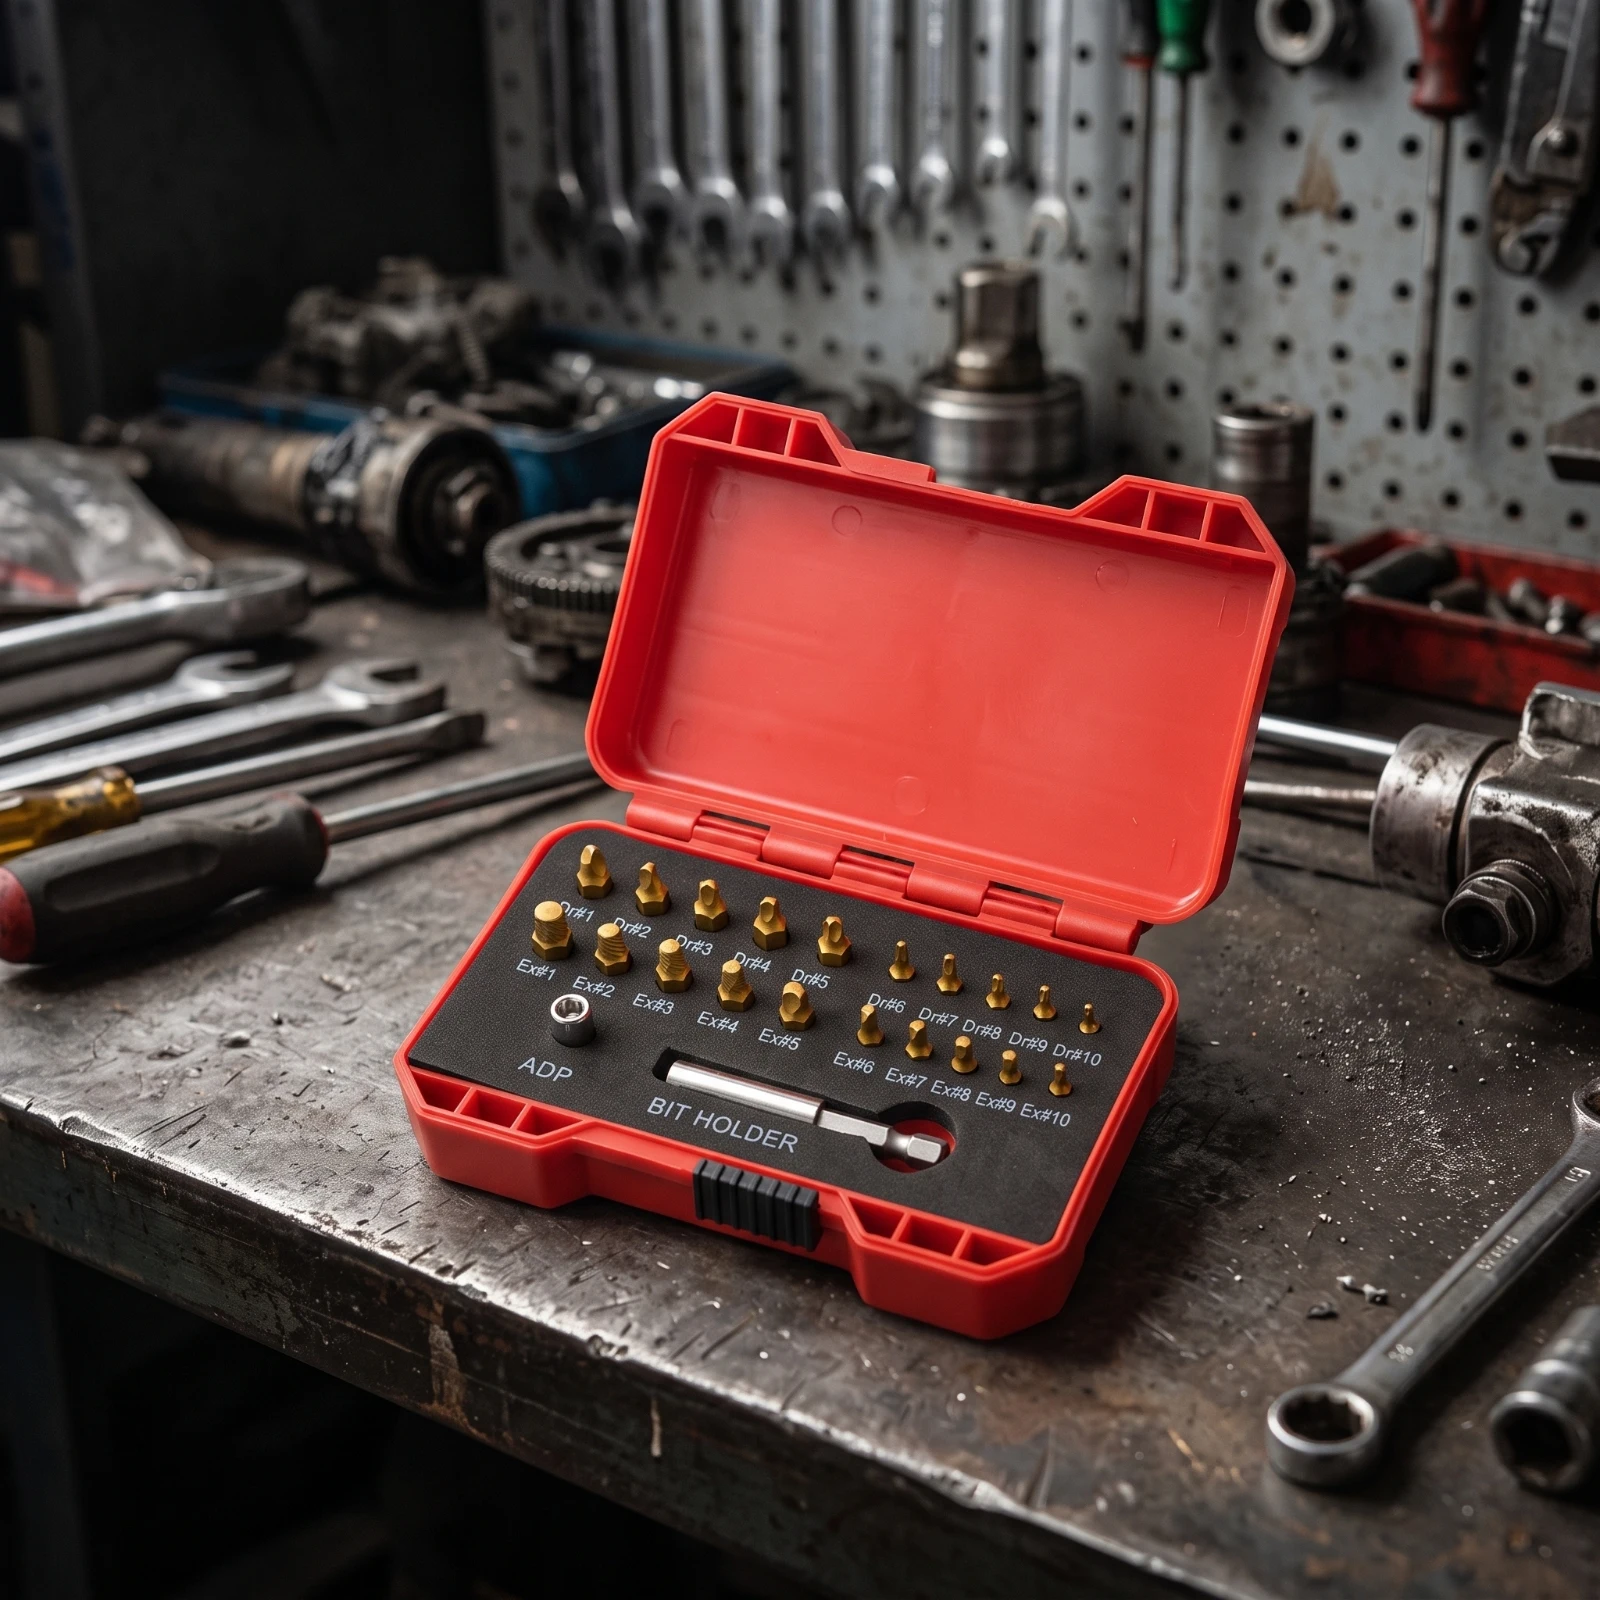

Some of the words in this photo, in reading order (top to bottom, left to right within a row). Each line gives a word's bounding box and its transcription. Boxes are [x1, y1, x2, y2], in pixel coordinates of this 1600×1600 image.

[614, 916, 652, 939] Dr#2
[676, 933, 714, 956] Dr#3
[515, 957, 557, 981] Ex#1
[734, 951, 772, 973] Dr#4
[572, 975, 616, 998] Ex#2
[790, 968, 831, 989] Dr#5
[632, 992, 675, 1015] Ex#3
[868, 992, 907, 1014] Dr#6
[696, 1010, 740, 1034] Ex#4
[918, 1006, 959, 1028] Dr#7
[757, 1027, 802, 1051] Ex#5
[961, 1018, 1003, 1040] Dr#8
[1008, 1031, 1049, 1053] Dr#9
[832, 1050, 876, 1074] Ex#6
[1052, 1043, 1102, 1067] Dr#10
[517, 1056, 573, 1082] ADP
[884, 1066, 928, 1089] Ex#7
[930, 1079, 972, 1102] Ex#8
[974, 1091, 1017, 1113] Ex#9
[646, 1096, 693, 1121] BIT
[692, 1109, 799, 1154] HOLDER
[1019, 1102, 1071, 1127] Ex#10
